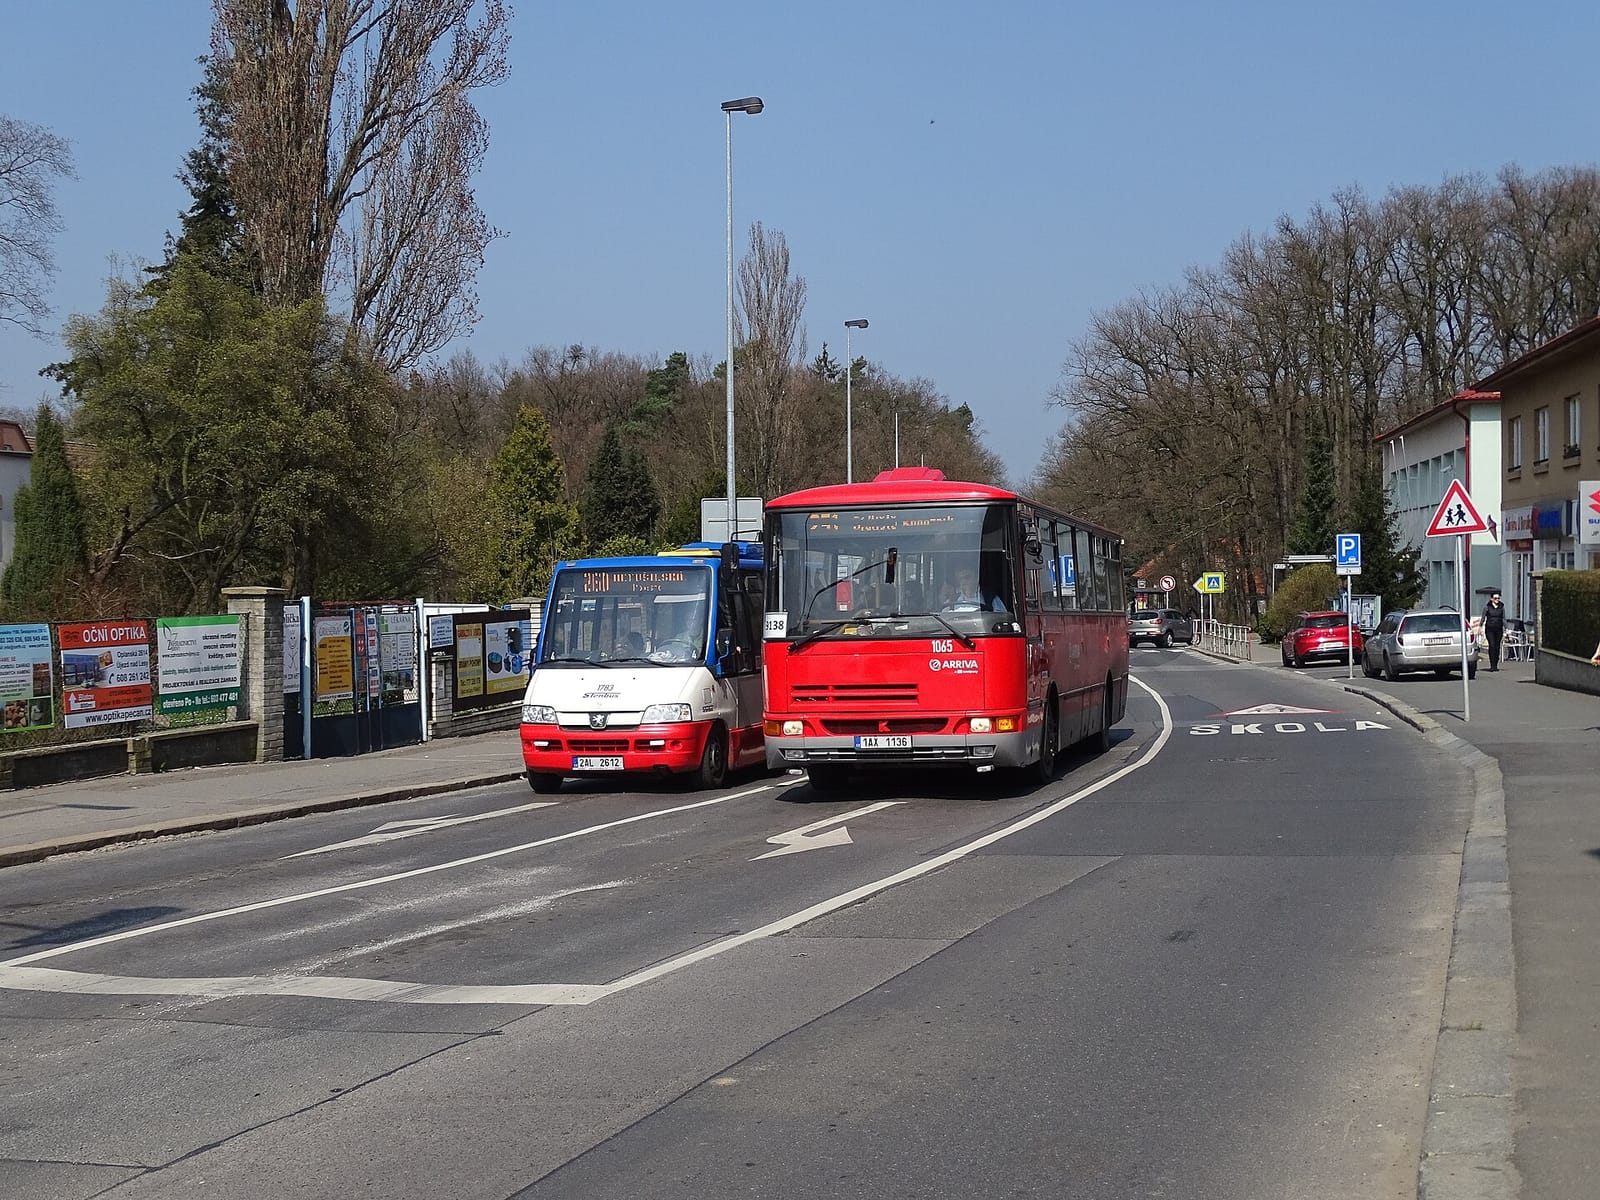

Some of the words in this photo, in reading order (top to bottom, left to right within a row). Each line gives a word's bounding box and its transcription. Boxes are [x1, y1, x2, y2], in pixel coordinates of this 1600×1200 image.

[1342, 538, 1356, 557] P
[83, 626, 108, 643] OČNÍ
[110, 626, 146, 641] OPTIKA
[932, 640, 953, 653] 1065
[942, 660, 978, 669] ARRIVA
[863, 738, 879, 747] 1AX
[886, 737, 907, 746] 1136
[580, 758, 594, 767] 2AL
[600, 758, 619, 767] 2612
